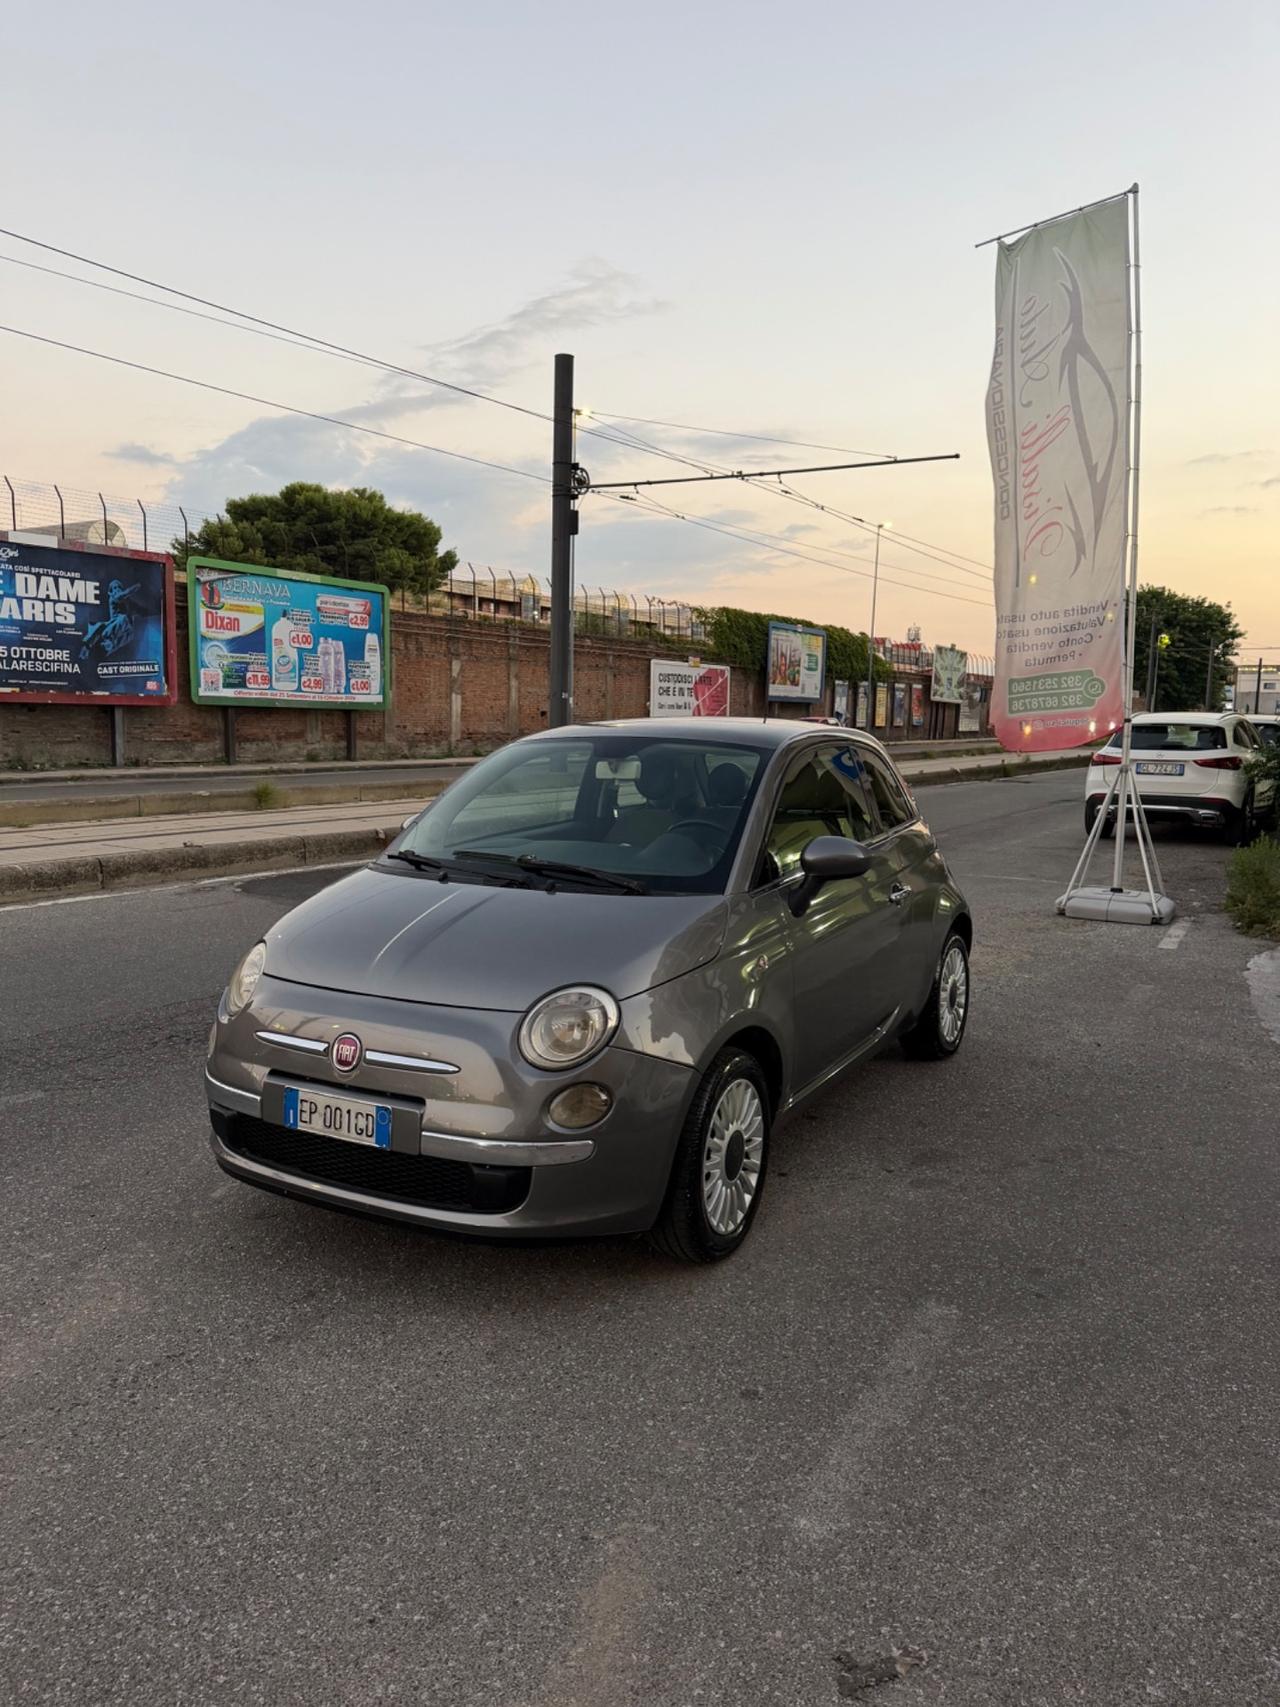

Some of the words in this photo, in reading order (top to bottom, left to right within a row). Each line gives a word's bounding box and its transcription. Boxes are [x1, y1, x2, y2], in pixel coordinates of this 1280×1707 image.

[15, 573, 100, 604] DAME
[222, 579, 291, 599] BERNAVA
[0, 597, 76, 624] ARIS
[205, 610, 240, 632] Dixan
[11, 647, 70, 661] OTTOBRE
[0, 660, 81, 674] LARESCIFINA
[97, 665, 118, 674] CAST
[119, 664, 160, 673] ORIGINALE
[658, 687, 671, 696] CHE
[338, 1044, 355, 1061] FIAT
[299, 1098, 318, 1125] EP
[323, 1104, 375, 1138] 001GD
